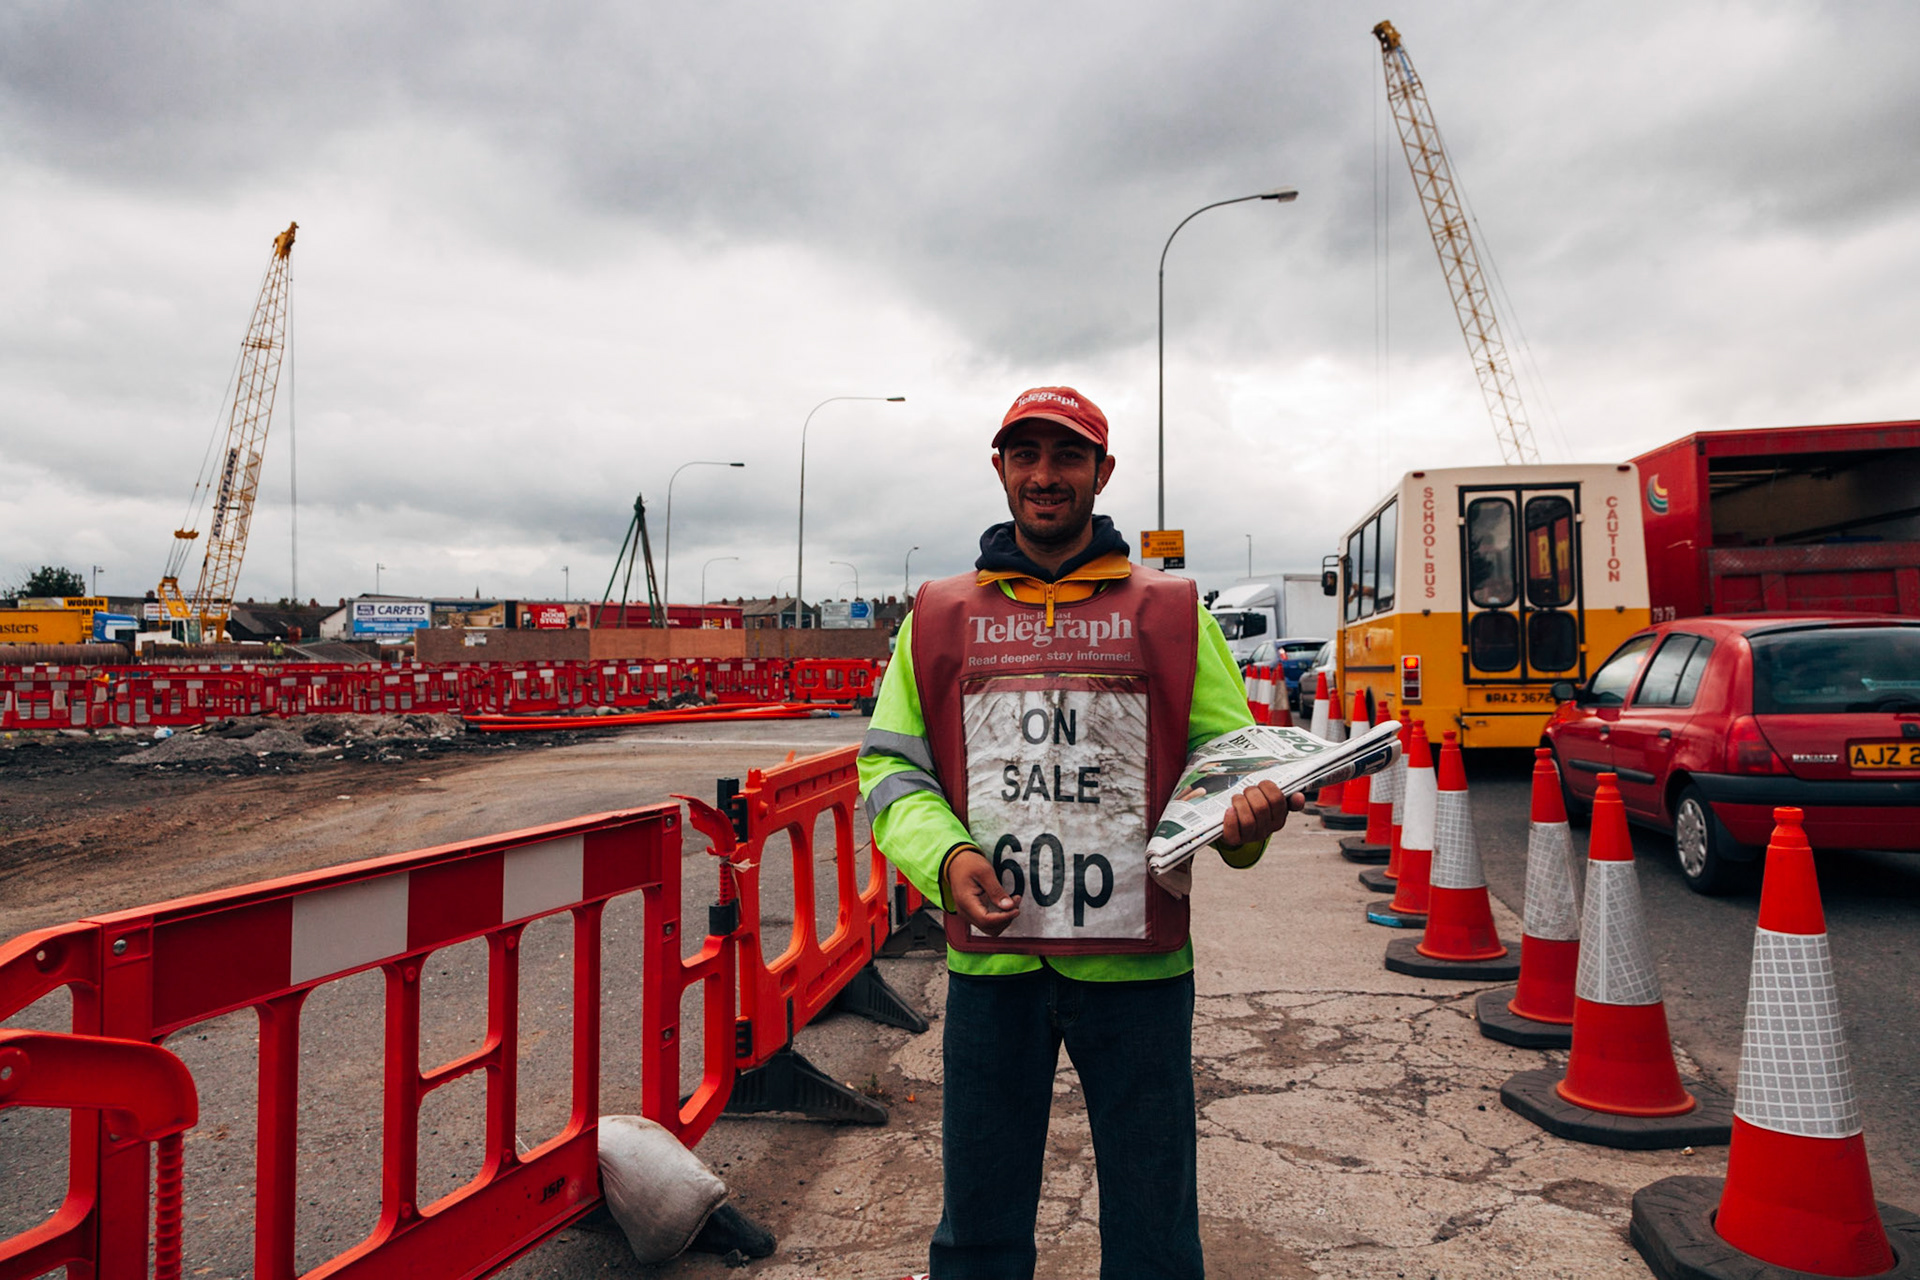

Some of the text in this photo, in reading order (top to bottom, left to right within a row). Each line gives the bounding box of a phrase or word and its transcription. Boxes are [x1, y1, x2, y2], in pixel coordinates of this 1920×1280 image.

[1016, 392, 1079, 408] Telegraph
[1423, 487, 1436, 599] SCHOOL BUS
[1606, 496, 1621, 582] CAUTION
[67, 599, 105, 607] WOODEN
[378, 605, 426, 616] CARPETS
[1017, 612, 1035, 621] The
[968, 612, 1133, 648] Telegraph
[968, 650, 1134, 666] Read deeper, stay informed.
[1022, 708, 1076, 745] ON
[1792, 754, 1838, 764] RENAULT
[1854, 747, 1901, 765] AJZ
[1001, 764, 1101, 803] SALE
[993, 833, 1114, 927] 60p
